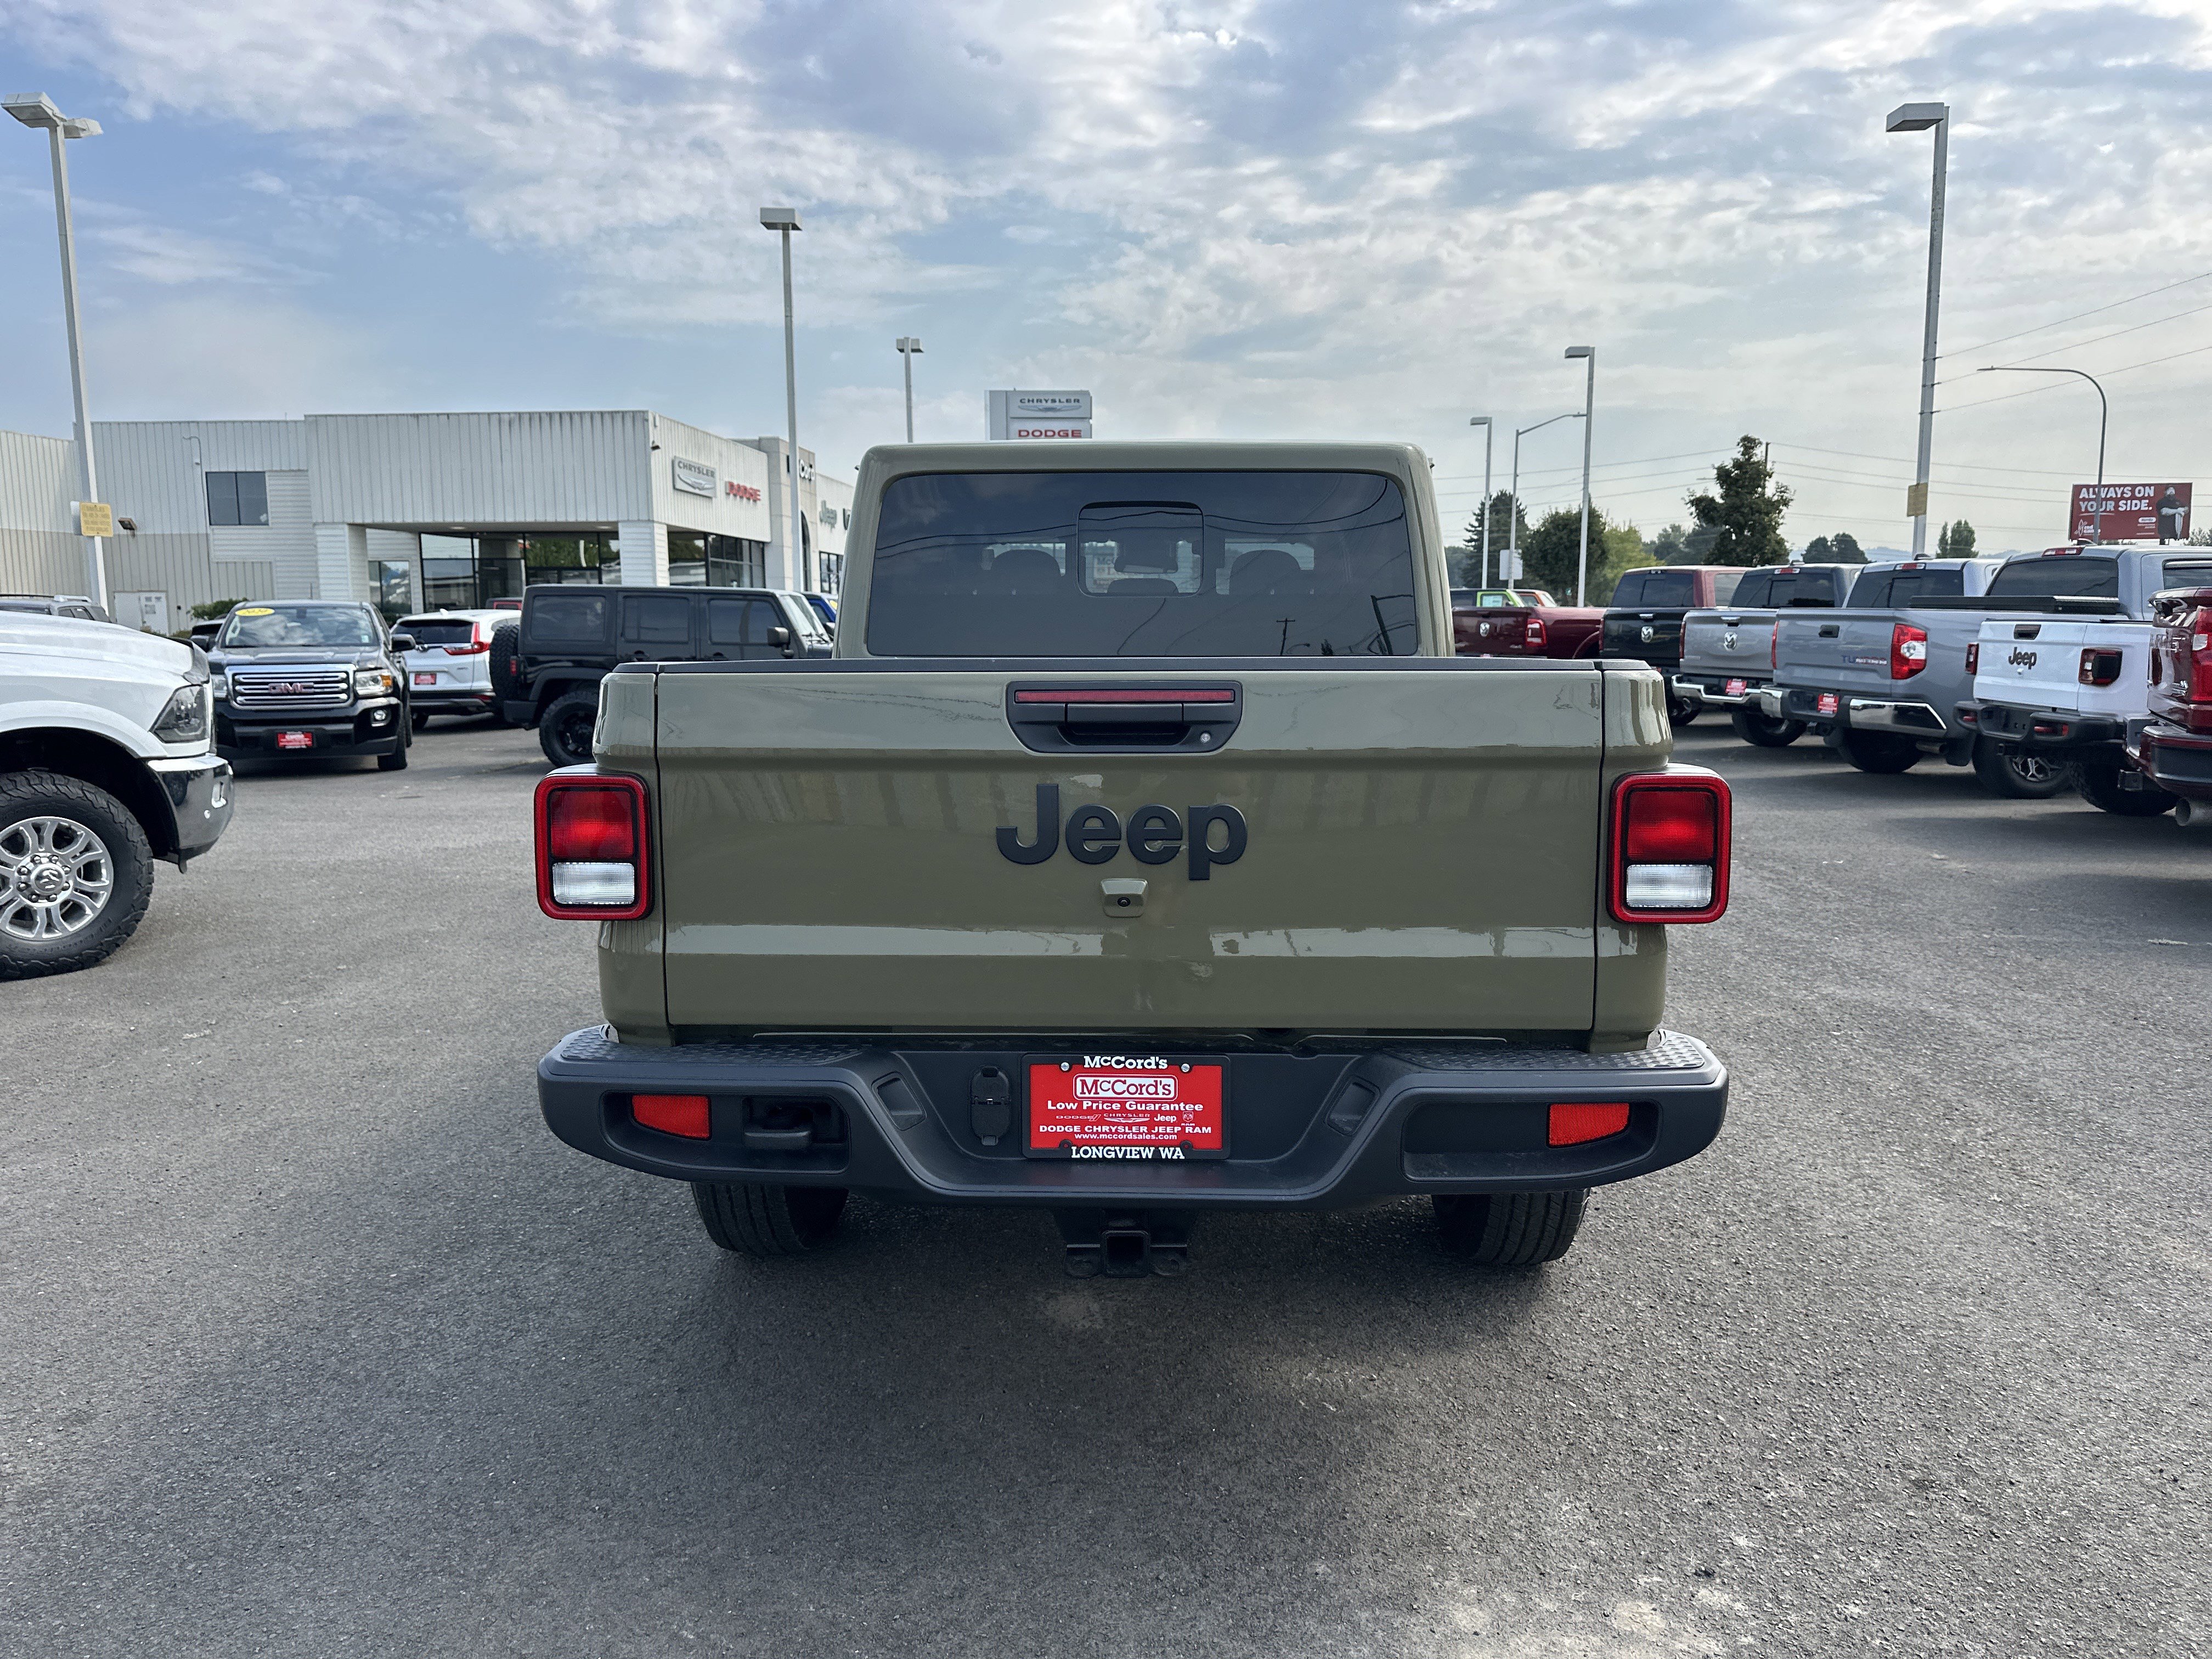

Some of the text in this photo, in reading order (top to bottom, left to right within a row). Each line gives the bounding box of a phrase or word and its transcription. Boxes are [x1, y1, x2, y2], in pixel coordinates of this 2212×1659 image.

[678, 460, 715, 477] CHRYSLER
[725, 481, 761, 501] DODGE
[2079, 486, 2154, 499] ALWAYS ON
[2079, 499, 2152, 512] YOUR SIDE.
[2008, 646, 2037, 670] Jeep
[268, 682, 314, 693] GMC
[996, 783, 1248, 881] Jeep
[1084, 1056, 1168, 1069] McCord's
[1080, 1079, 1171, 1096] McCord's
[1047, 1100, 1204, 1111] Low Price Guarantee
[1154, 1114, 1177, 1123] Jeep
[1071, 1146, 1185, 1159] LONGVIEW WA
